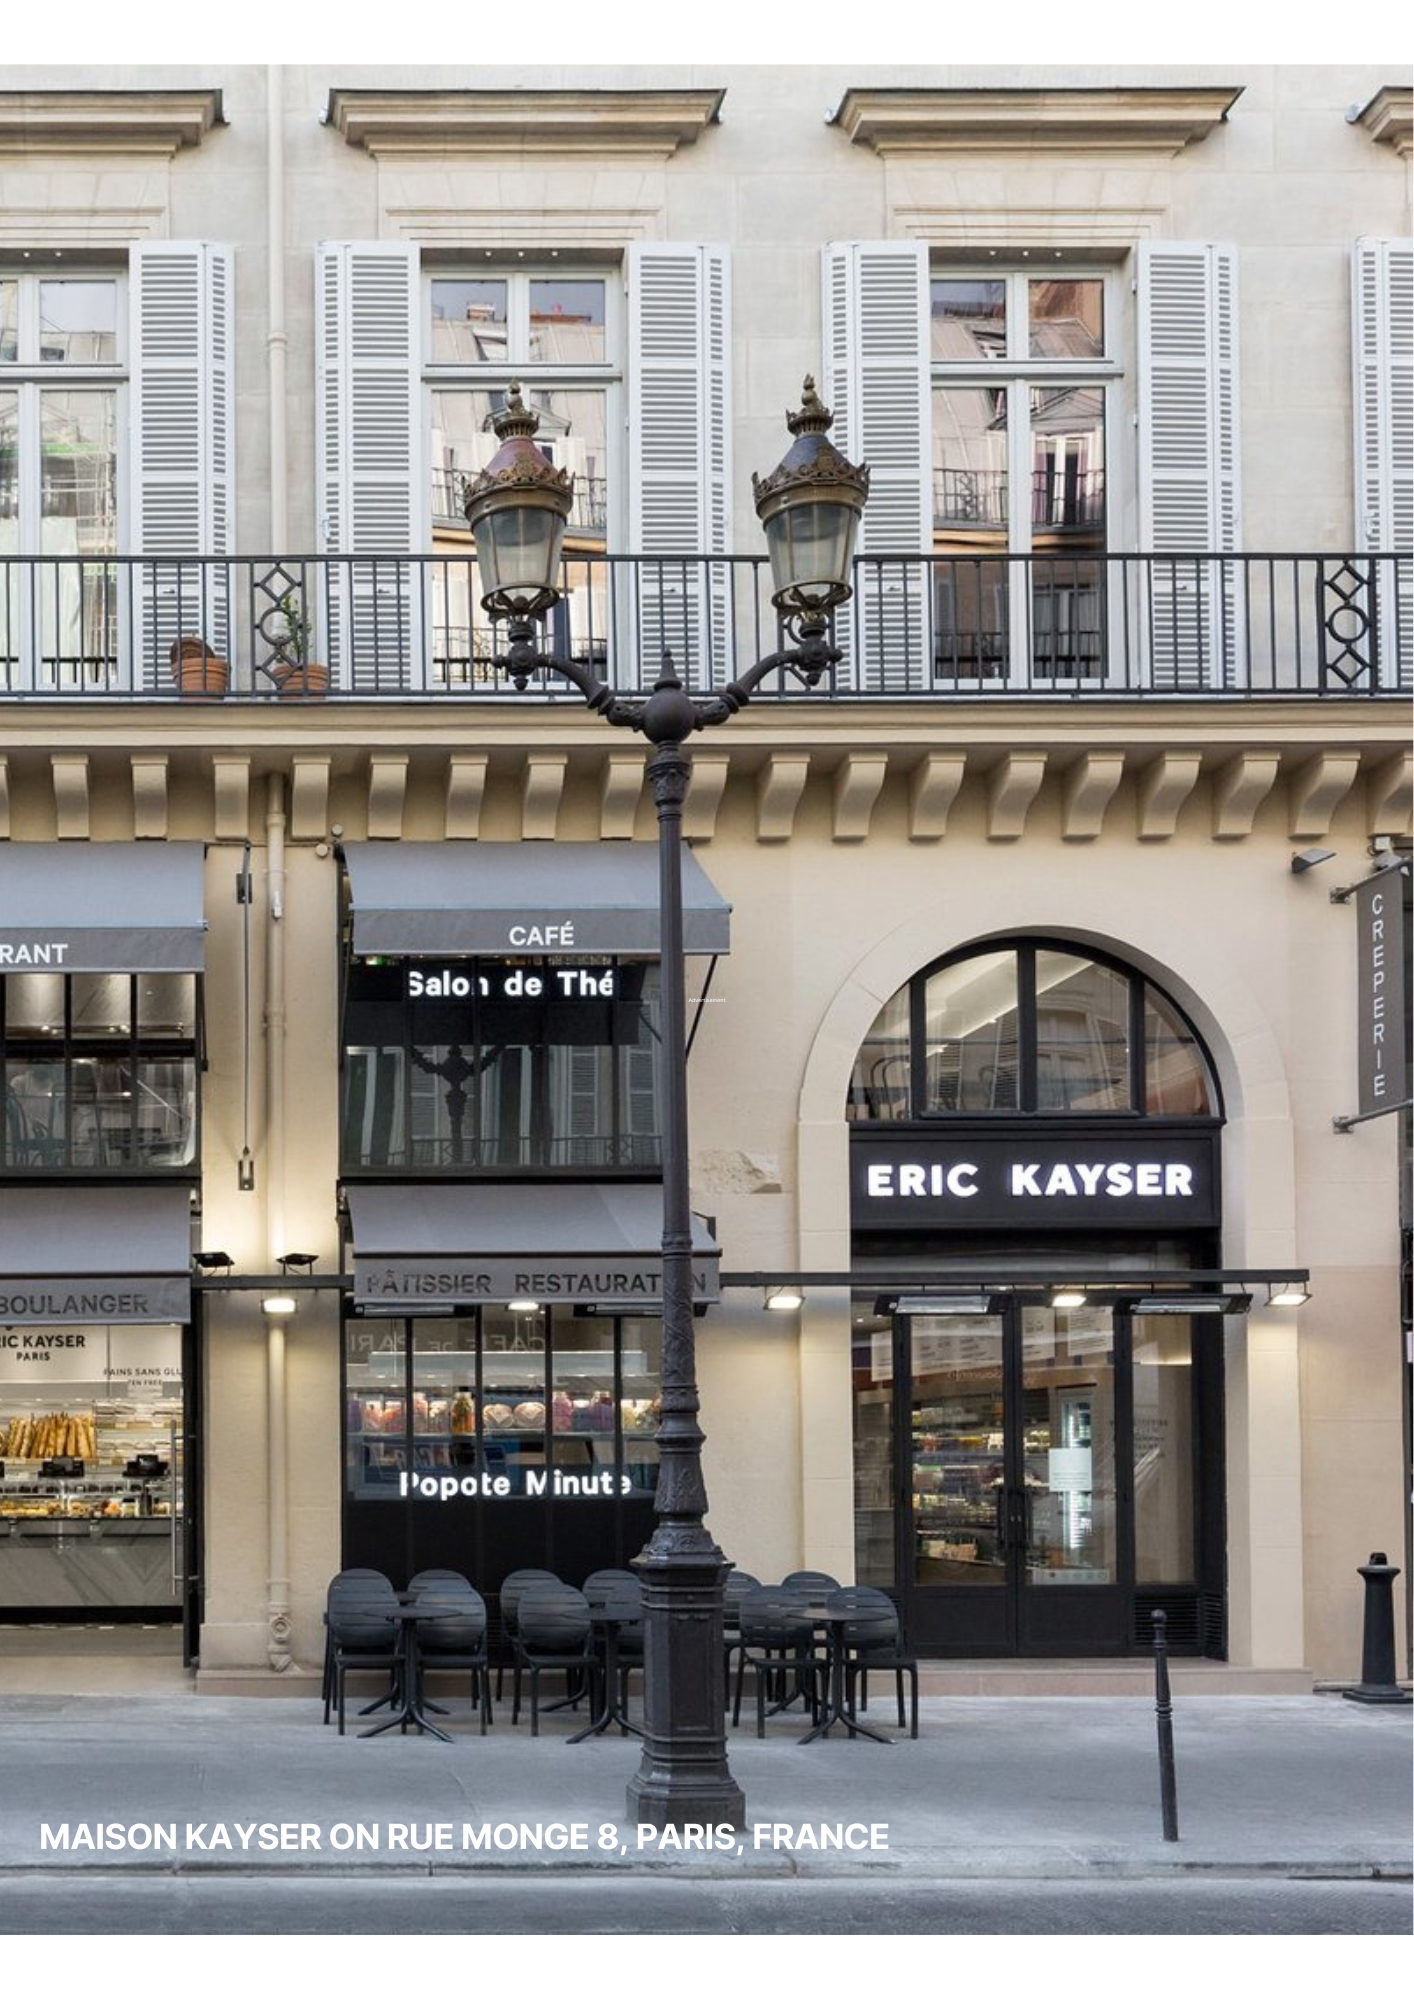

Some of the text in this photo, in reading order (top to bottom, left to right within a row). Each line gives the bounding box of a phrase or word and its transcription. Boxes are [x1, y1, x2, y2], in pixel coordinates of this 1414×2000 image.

[509, 921, 574, 946] CAFÉ
[0, 943, 68, 963] RANT
[504, 970, 543, 997] de
[557, 970, 613, 997] Thé
[1371, 894, 1386, 1097] CREPERIE
[868, 1163, 1193, 1197] ERIC KAYSER
[367, 1269, 706, 1293] PÂTISSIER RESTAURATN
[0, 1294, 148, 1314] BOULANGER
[0, 1335, 86, 1348] IC KAYSER
[16, 1351, 51, 1361] PARIS
[104, 1367, 133, 1376] PAINS
[134, 1367, 162, 1376] SANS
[399, 1471, 511, 1501] Popote
